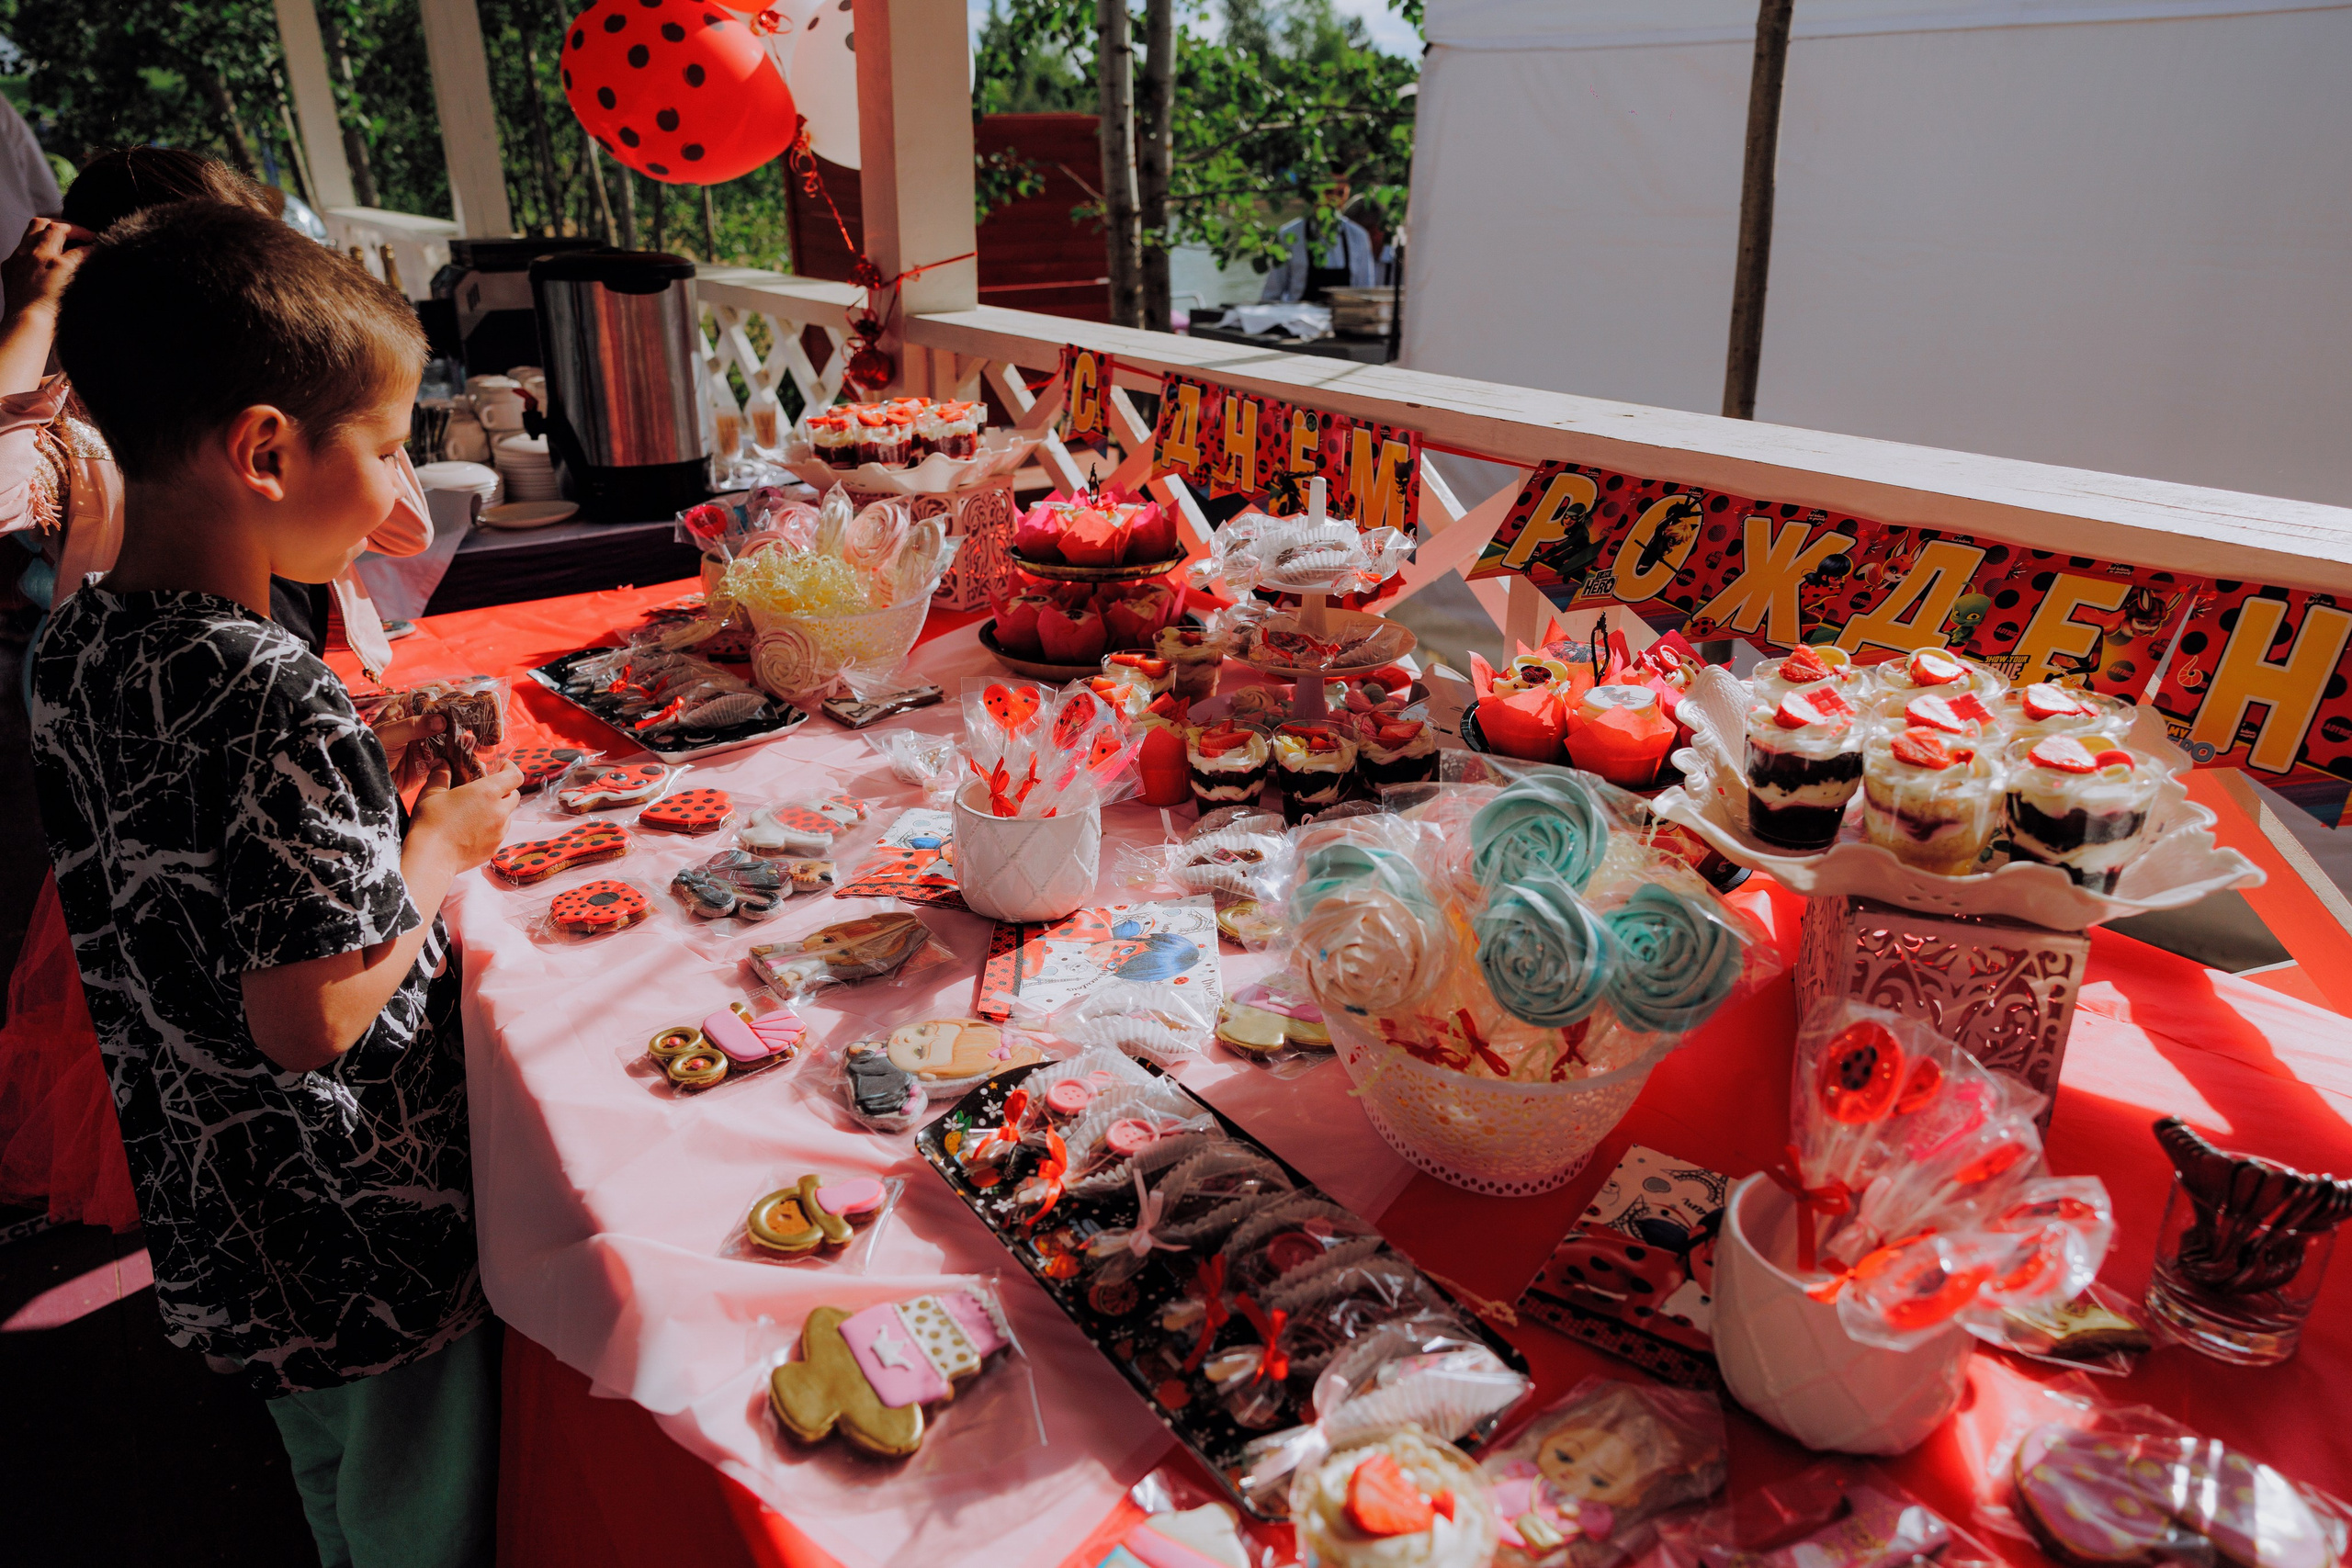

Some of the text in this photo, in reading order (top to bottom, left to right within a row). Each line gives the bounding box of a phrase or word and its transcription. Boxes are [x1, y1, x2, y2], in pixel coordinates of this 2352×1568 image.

[1583, 578, 1615, 595] HERO
[1984, 655, 2029, 663] SHOW YOUR
[2168, 726, 2189, 739] MY
